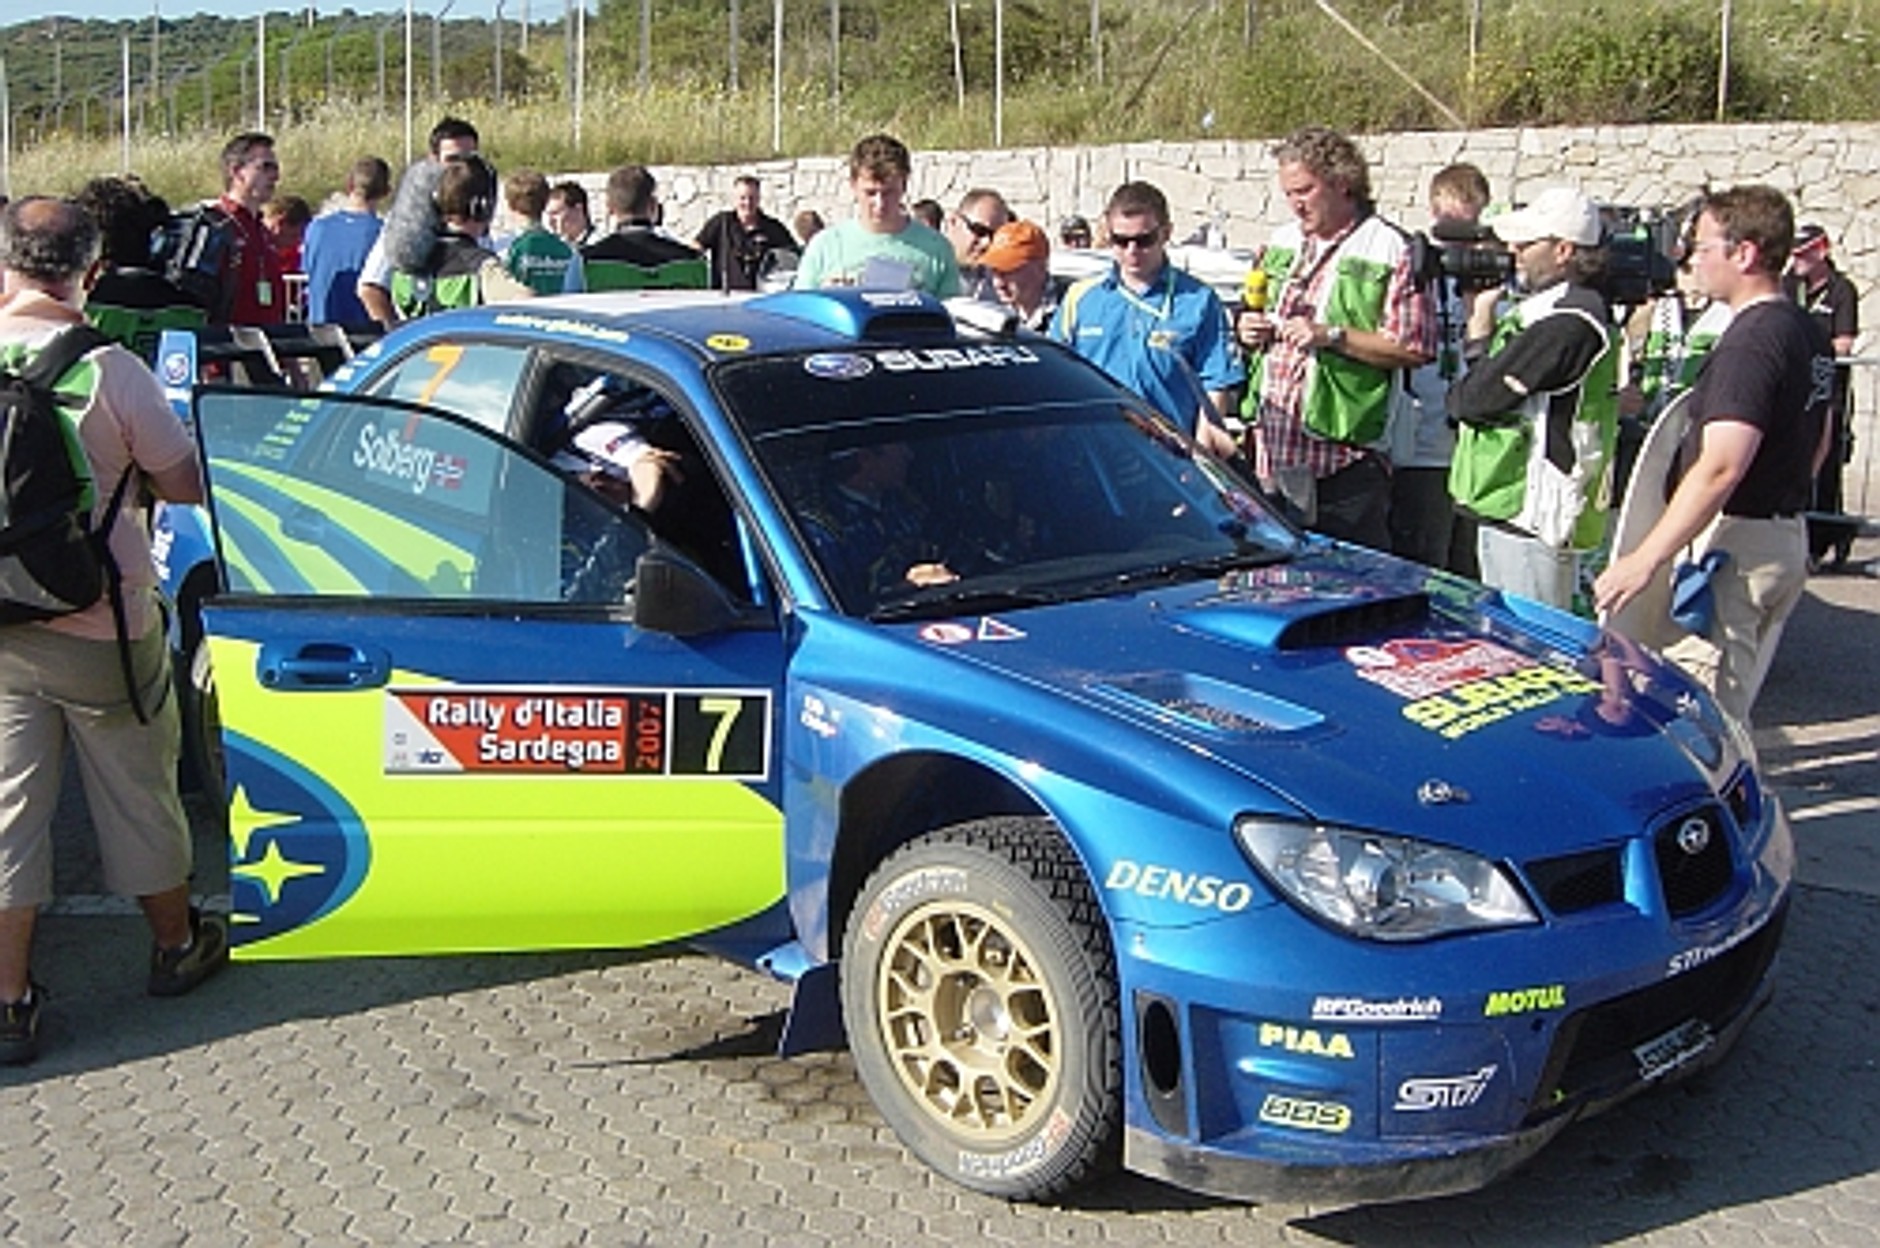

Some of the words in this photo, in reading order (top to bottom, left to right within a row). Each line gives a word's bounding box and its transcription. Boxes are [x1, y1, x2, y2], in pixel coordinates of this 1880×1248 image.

[875, 346, 1040, 371] SUBARU
[353, 422, 436, 495] Solberg
[428, 697, 506, 732] Rally
[514, 697, 623, 727] d'Italia
[479, 733, 622, 769] Sardegna
[636, 700, 661, 770] 2007
[699, 697, 742, 773] 7
[1104, 859, 1253, 913] DENSO
[1312, 996, 1442, 1019] BFGoodrich
[1485, 985, 1565, 1016] MOTUL
[1259, 1022, 1354, 1058] PIAA
